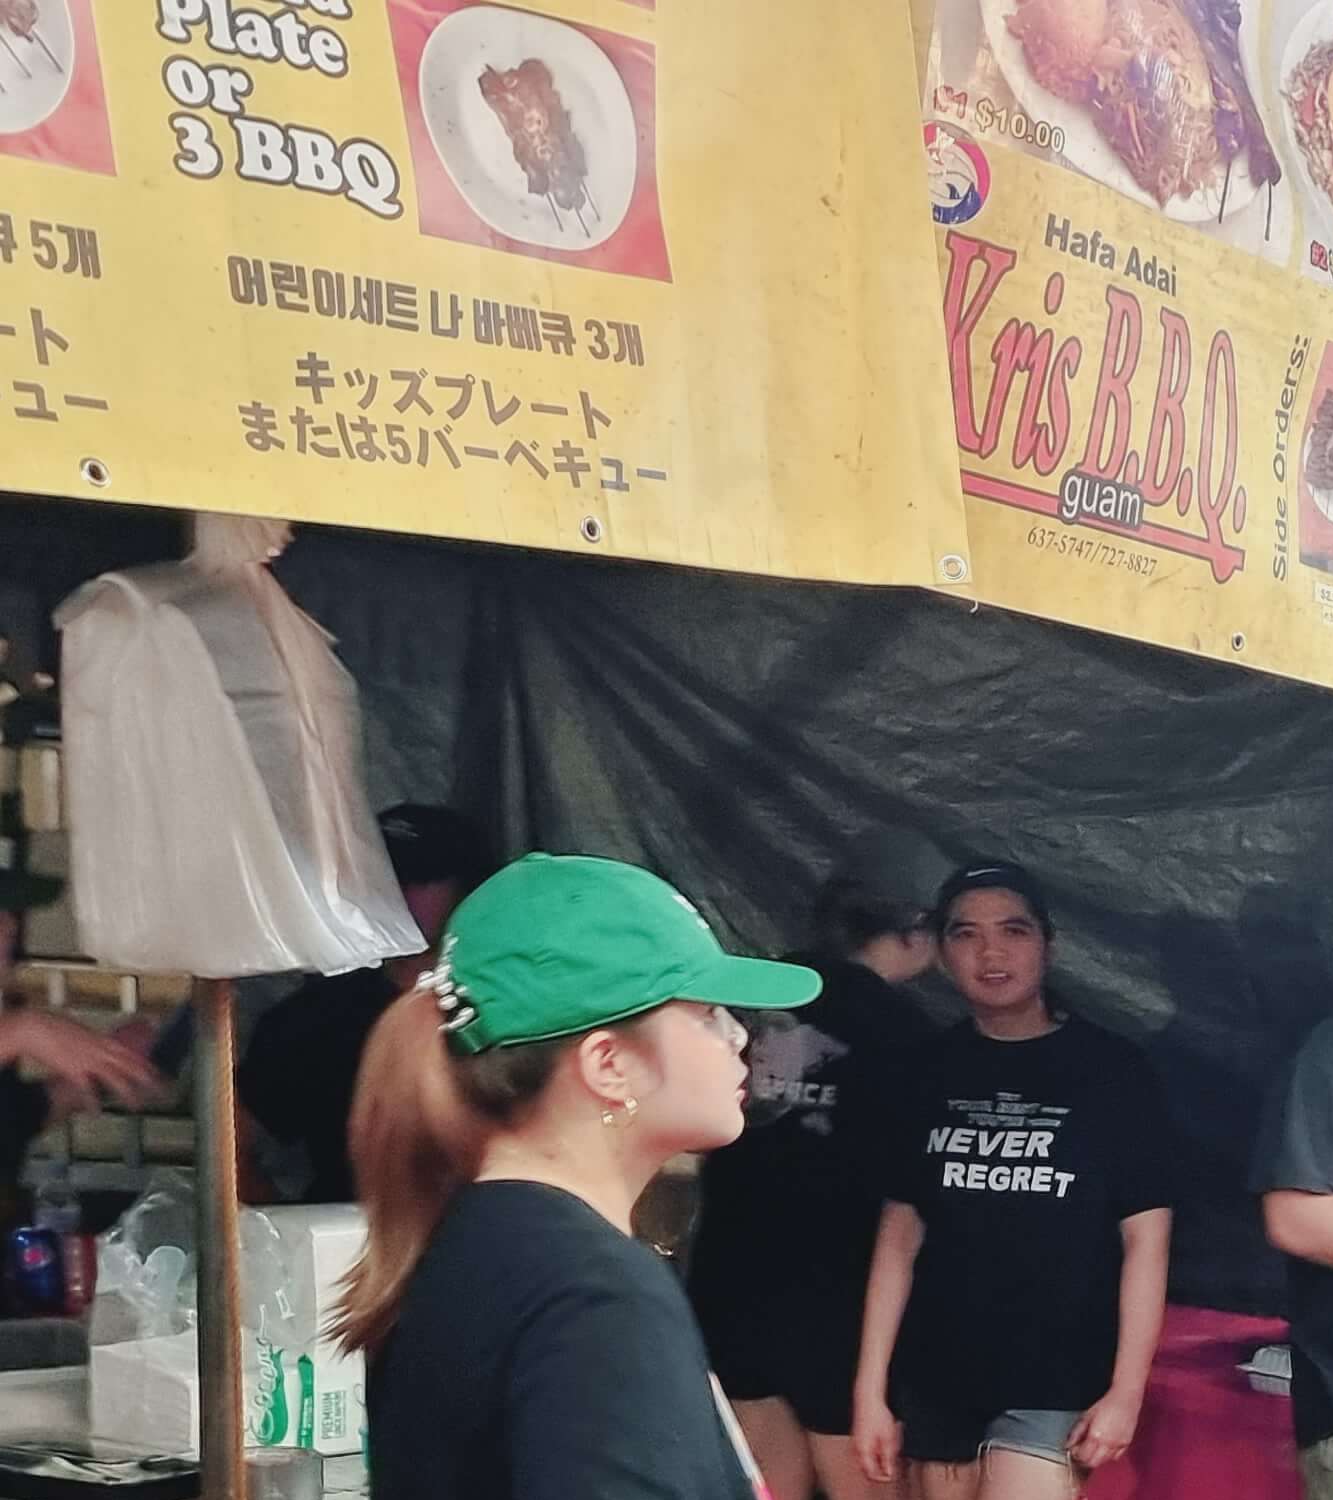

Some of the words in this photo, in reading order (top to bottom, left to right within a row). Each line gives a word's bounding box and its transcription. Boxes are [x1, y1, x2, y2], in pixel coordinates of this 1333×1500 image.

[162, 54, 254, 115] or
[975, 97, 1066, 154] $10.00
[168, 112, 224, 180] 3
[230, 114, 405, 220] BBQ
[1044, 213, 1117, 274] Hafa
[1123, 246, 1179, 297] Adai
[587, 319, 646, 368] 3개
[295, 351, 613, 441] キッズプレート
[1272, 334, 1310, 484] Orders:
[1060, 471, 1143, 529] guam
[1272, 496, 1288, 582] Side
[926, 1126, 1055, 1158] NEVER
[942, 1161, 1076, 1199] REGRET
